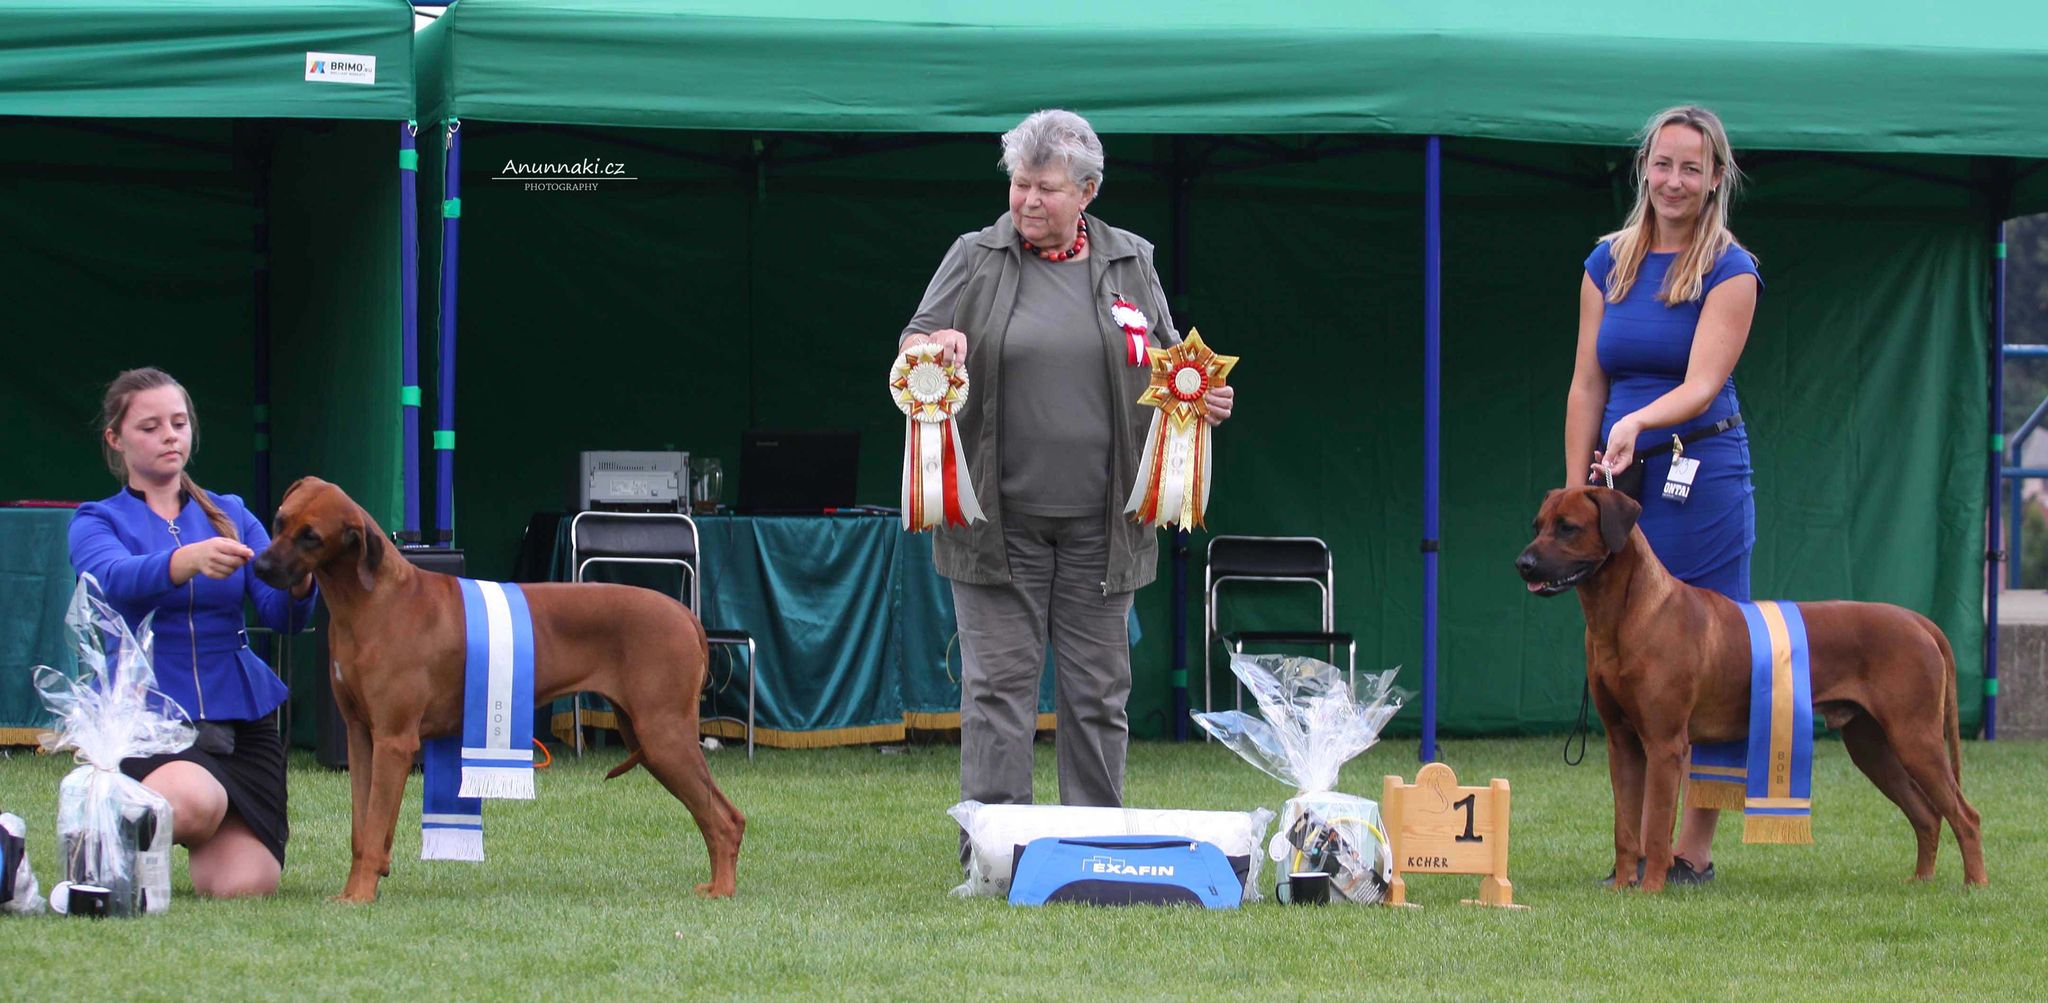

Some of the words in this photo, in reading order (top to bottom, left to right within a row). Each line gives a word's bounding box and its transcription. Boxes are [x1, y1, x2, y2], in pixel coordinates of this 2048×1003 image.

[494, 700, 503, 736] BOS
[1453, 793, 1484, 843] 1
[1092, 863, 1175, 877] EXAFIN
[1408, 856, 1449, 868] KCHRR
